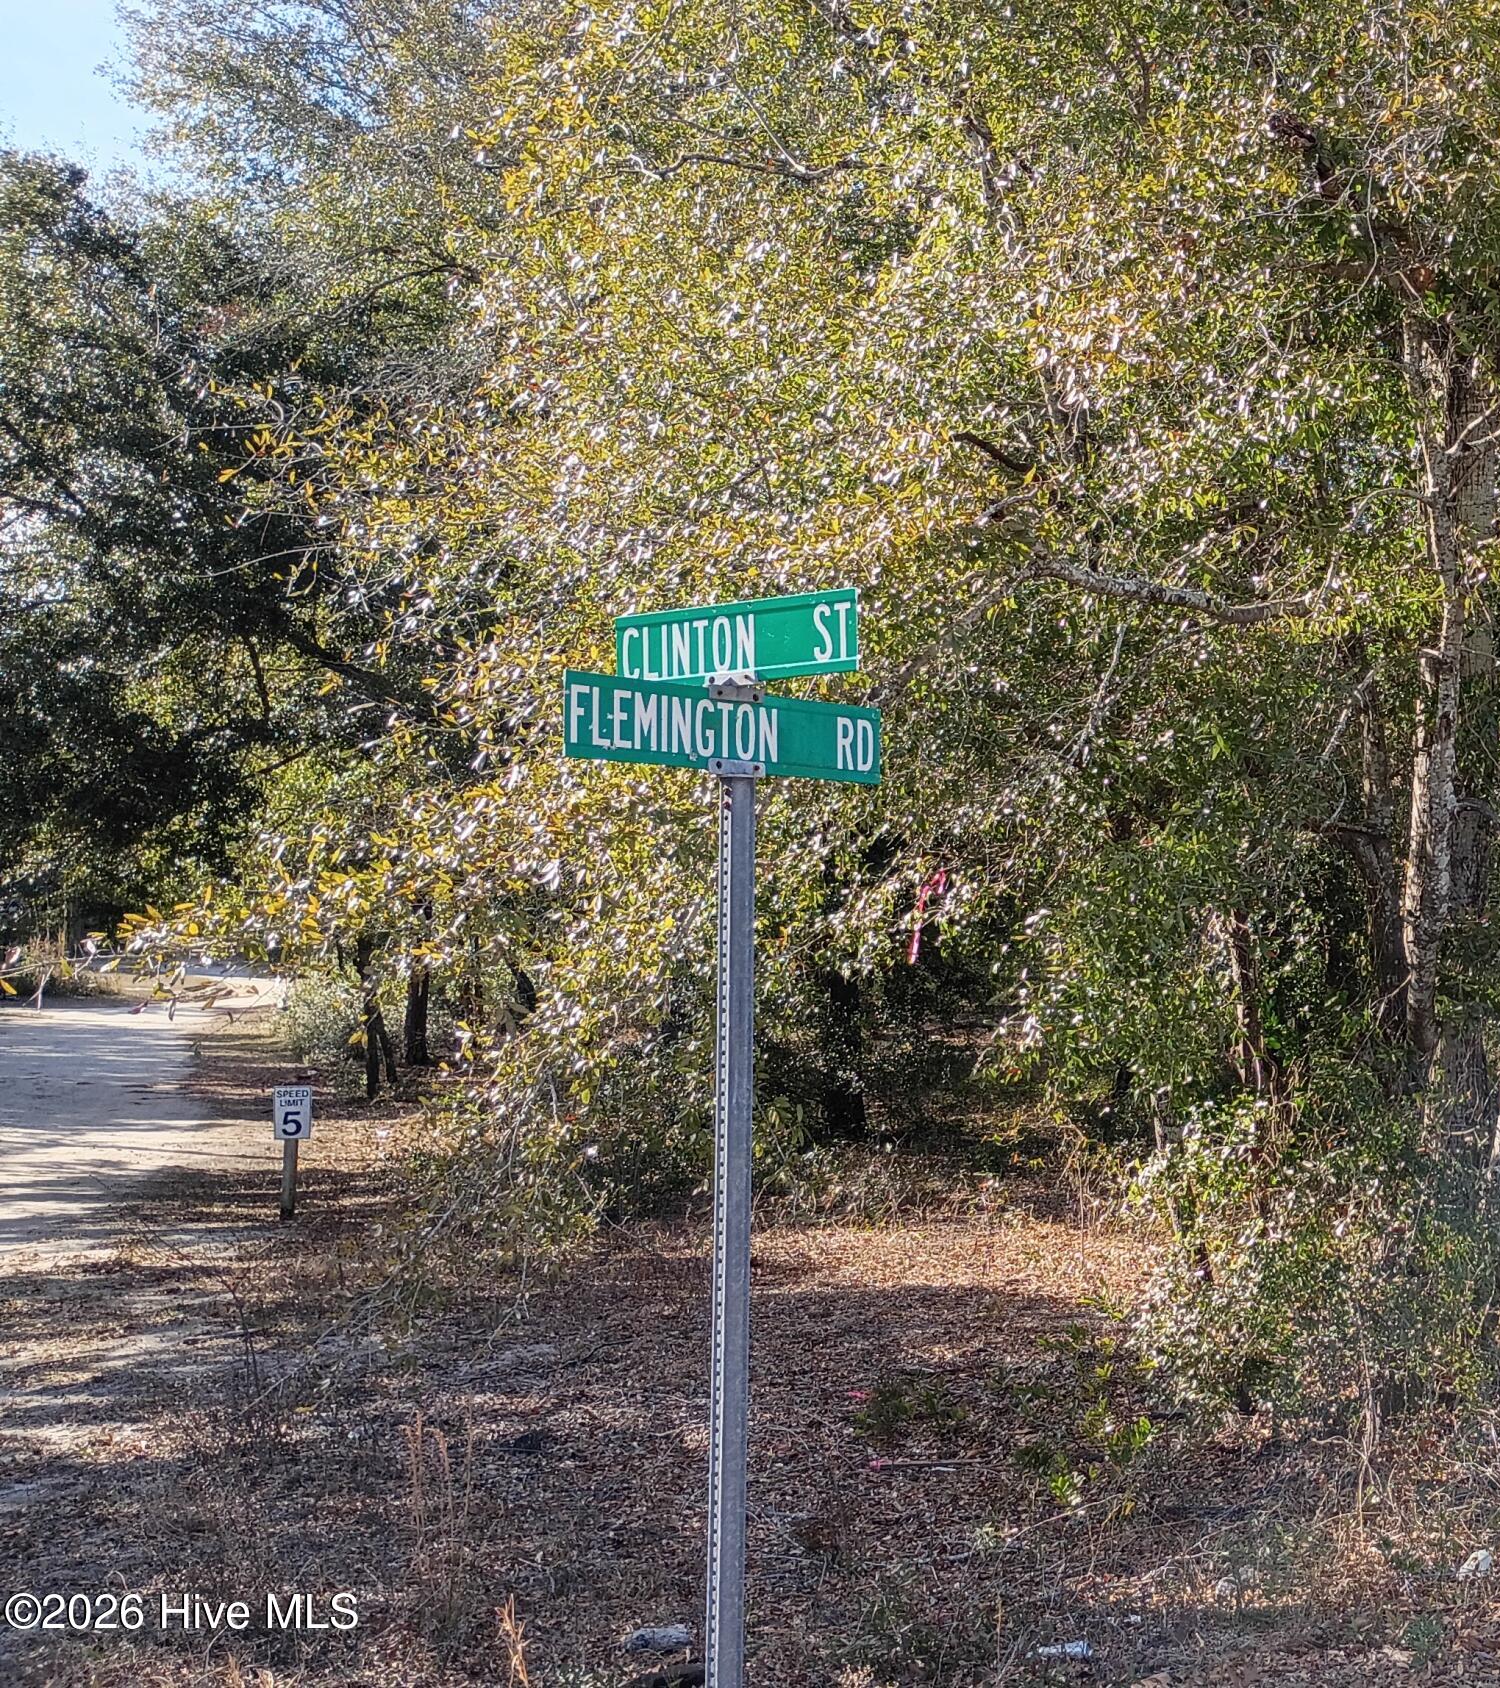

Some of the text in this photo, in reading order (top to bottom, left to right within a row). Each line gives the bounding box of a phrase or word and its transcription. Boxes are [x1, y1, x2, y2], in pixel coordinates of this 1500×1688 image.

[622, 602, 851, 681] CLINTON ST
[569, 684, 874, 772] FLEMINGTON RD
[276, 1090, 309, 1098] SPEED
[280, 1099, 305, 1107] LIMIT
[281, 1111, 302, 1136] 5
